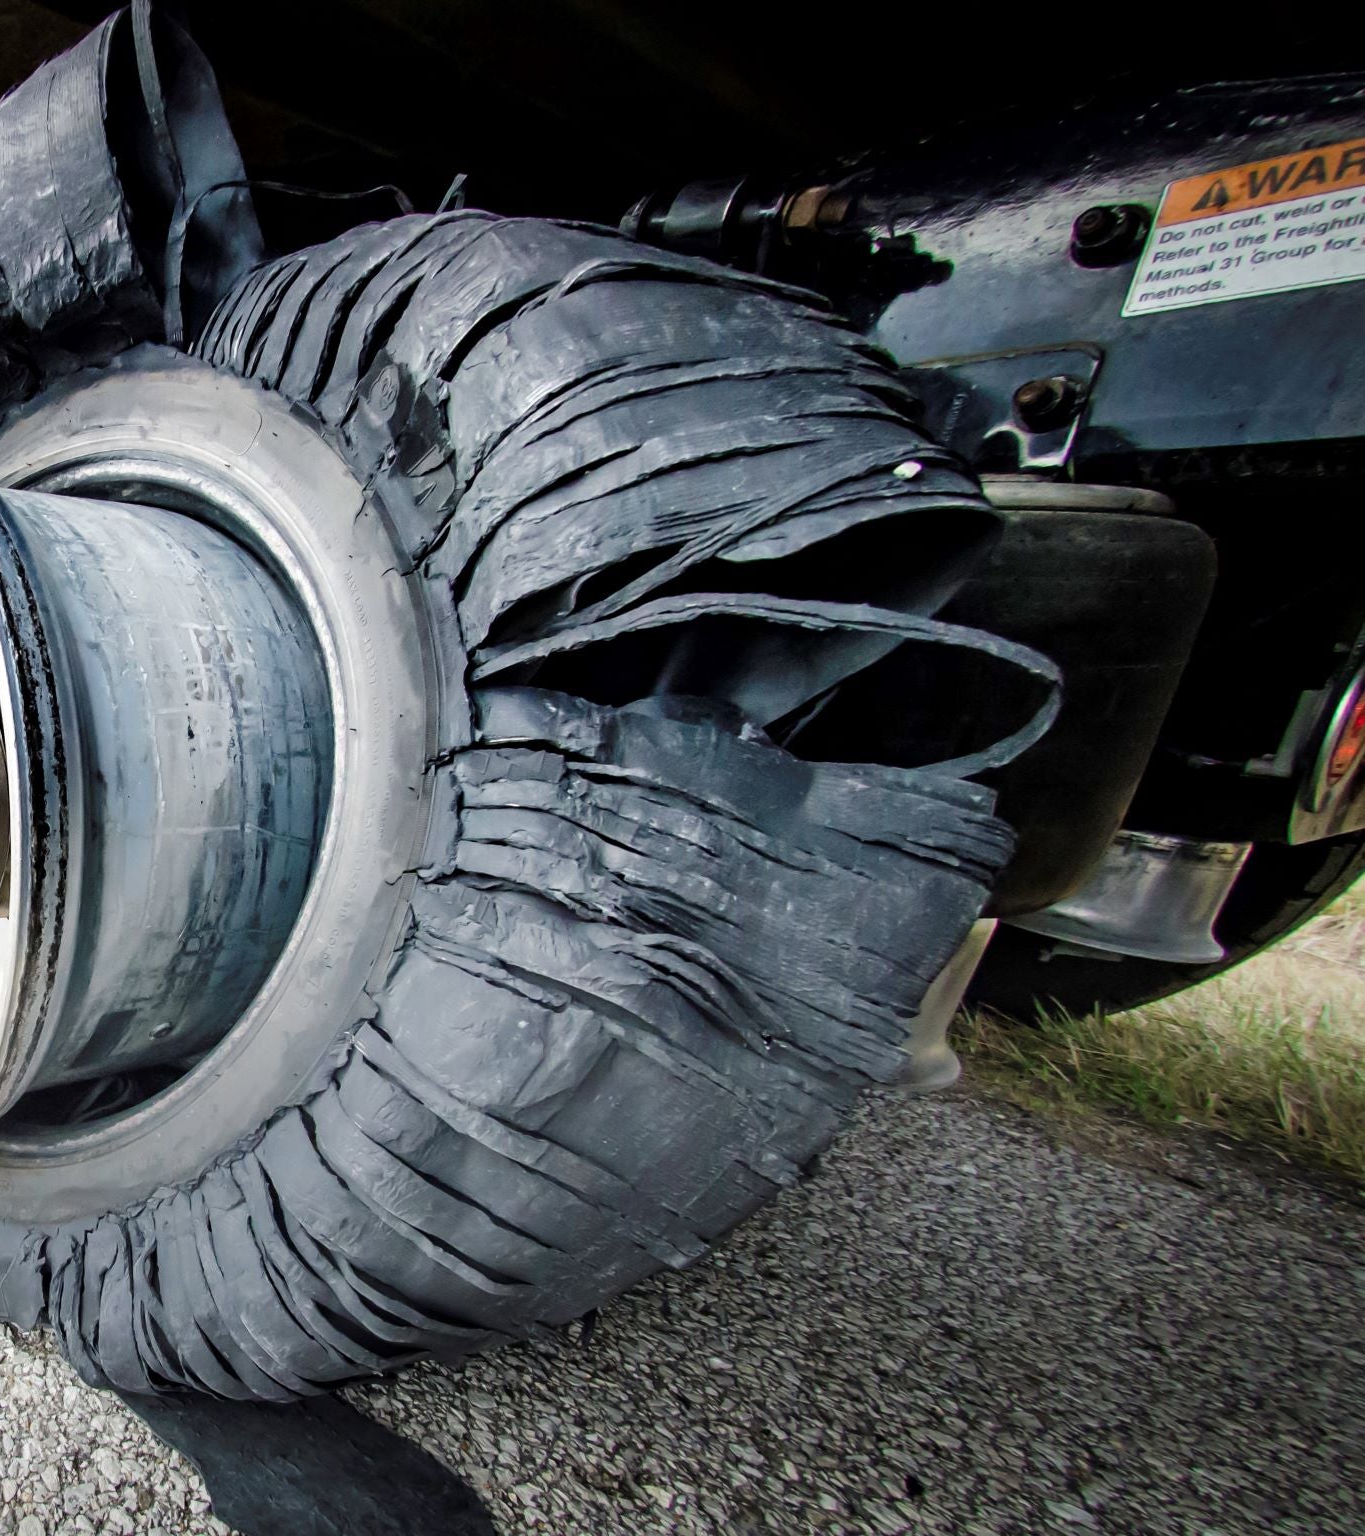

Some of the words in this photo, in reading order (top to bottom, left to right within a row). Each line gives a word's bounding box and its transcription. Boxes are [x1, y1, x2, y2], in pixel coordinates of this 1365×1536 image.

[1159, 231, 1185, 245] Do
[1191, 222, 1224, 238] not
[1229, 215, 1266, 231] cut,
[1274, 199, 1326, 222] weld
[1330, 196, 1357, 211] or
[1145, 263, 1214, 283] Manual
[1219, 255, 1243, 271] 31
[1250, 243, 1317, 265] Group
[1323, 236, 1357, 252] for
[1152, 245, 1205, 265] Refer
[1209, 240, 1229, 253] to
[1236, 233, 1267, 248] the
[1139, 278, 1227, 302] methods.
